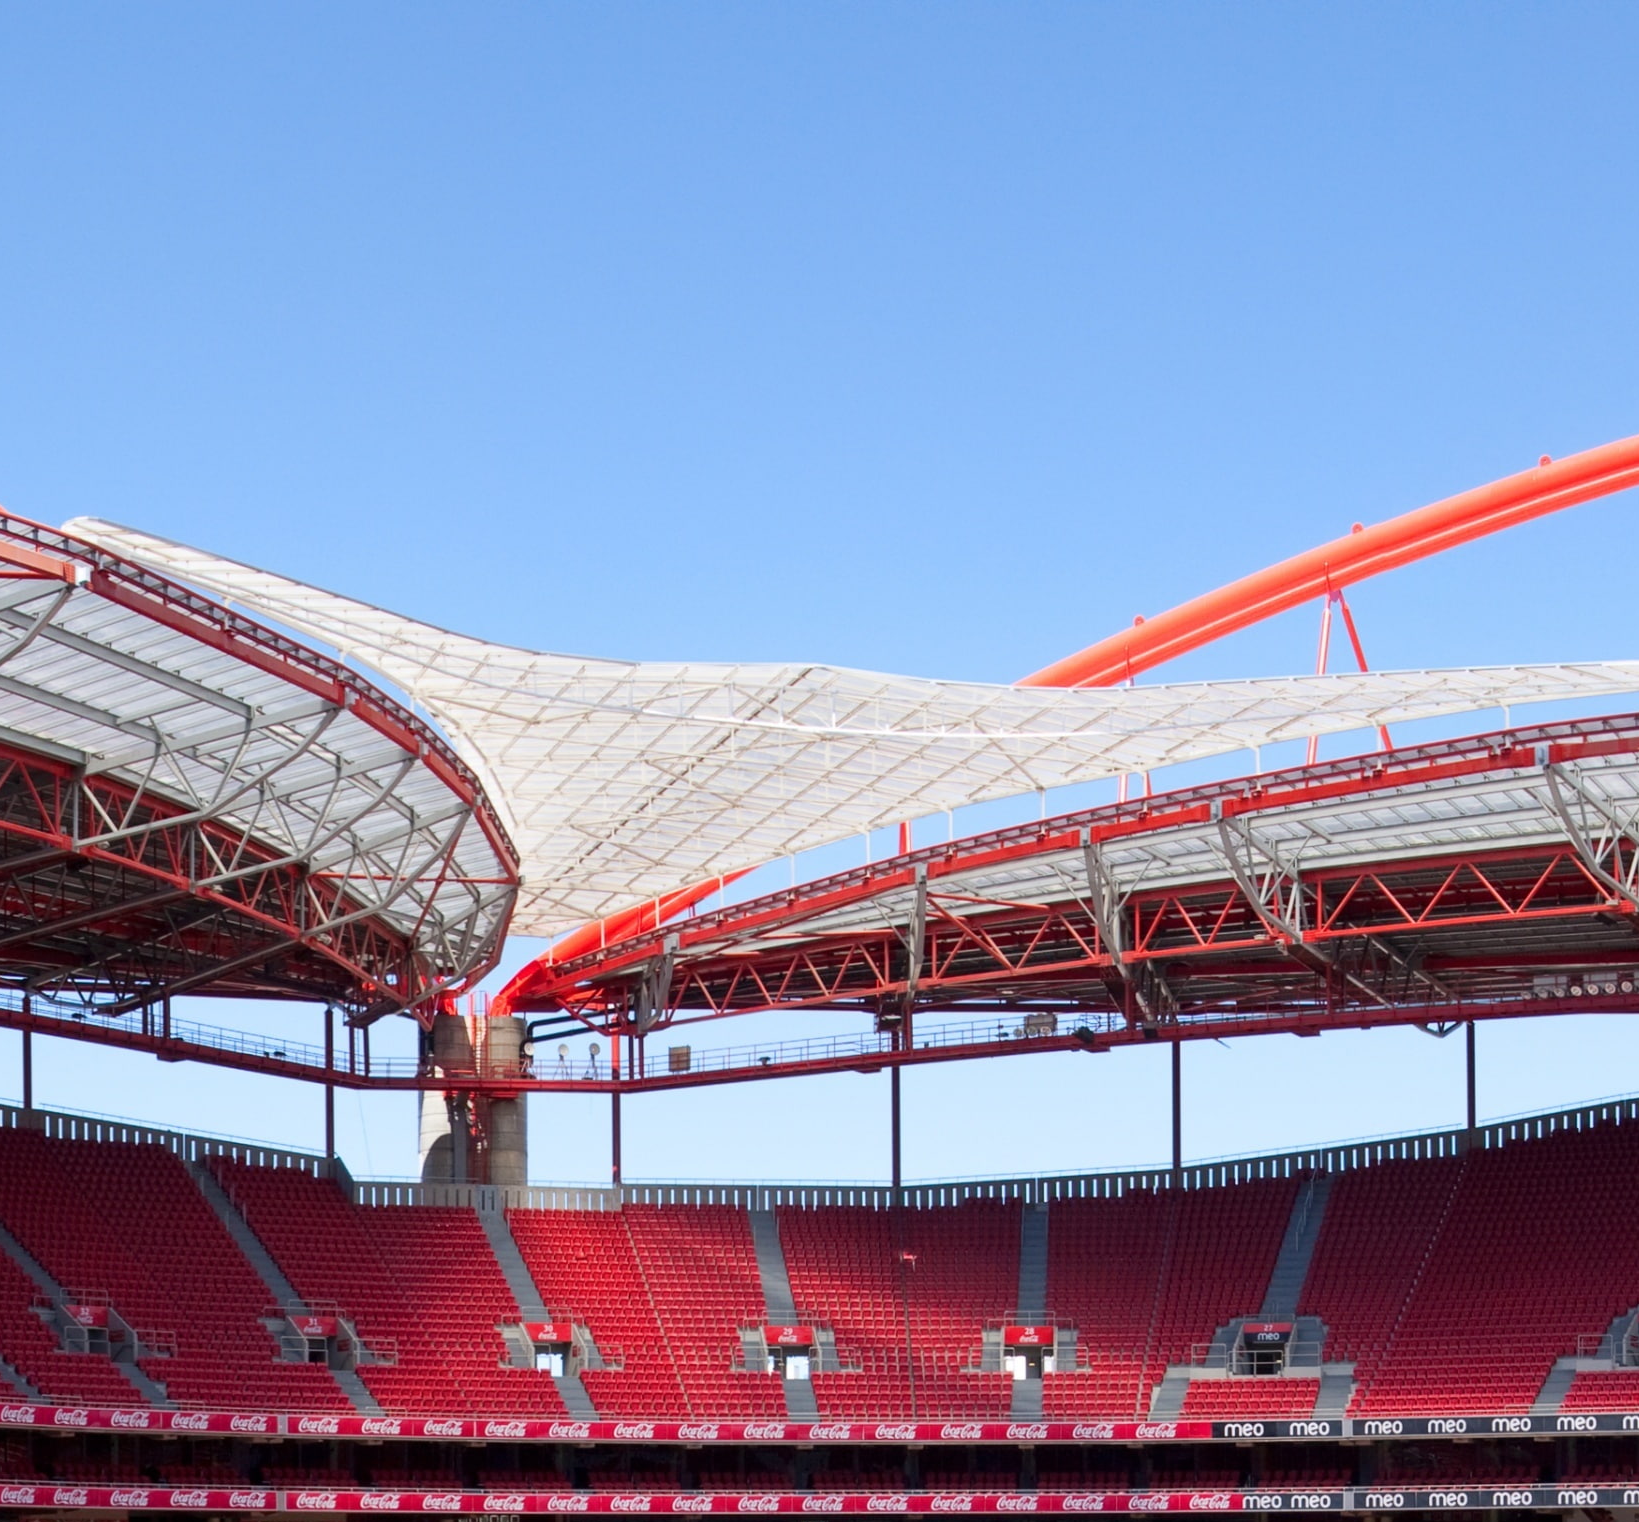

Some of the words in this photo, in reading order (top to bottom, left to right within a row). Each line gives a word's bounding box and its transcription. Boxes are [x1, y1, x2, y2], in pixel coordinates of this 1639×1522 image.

[298, 1416, 338, 1433] Coca-Cola
[1225, 1423, 1264, 1436] meo
[422, 1494, 462, 1511] Coca-Cola
